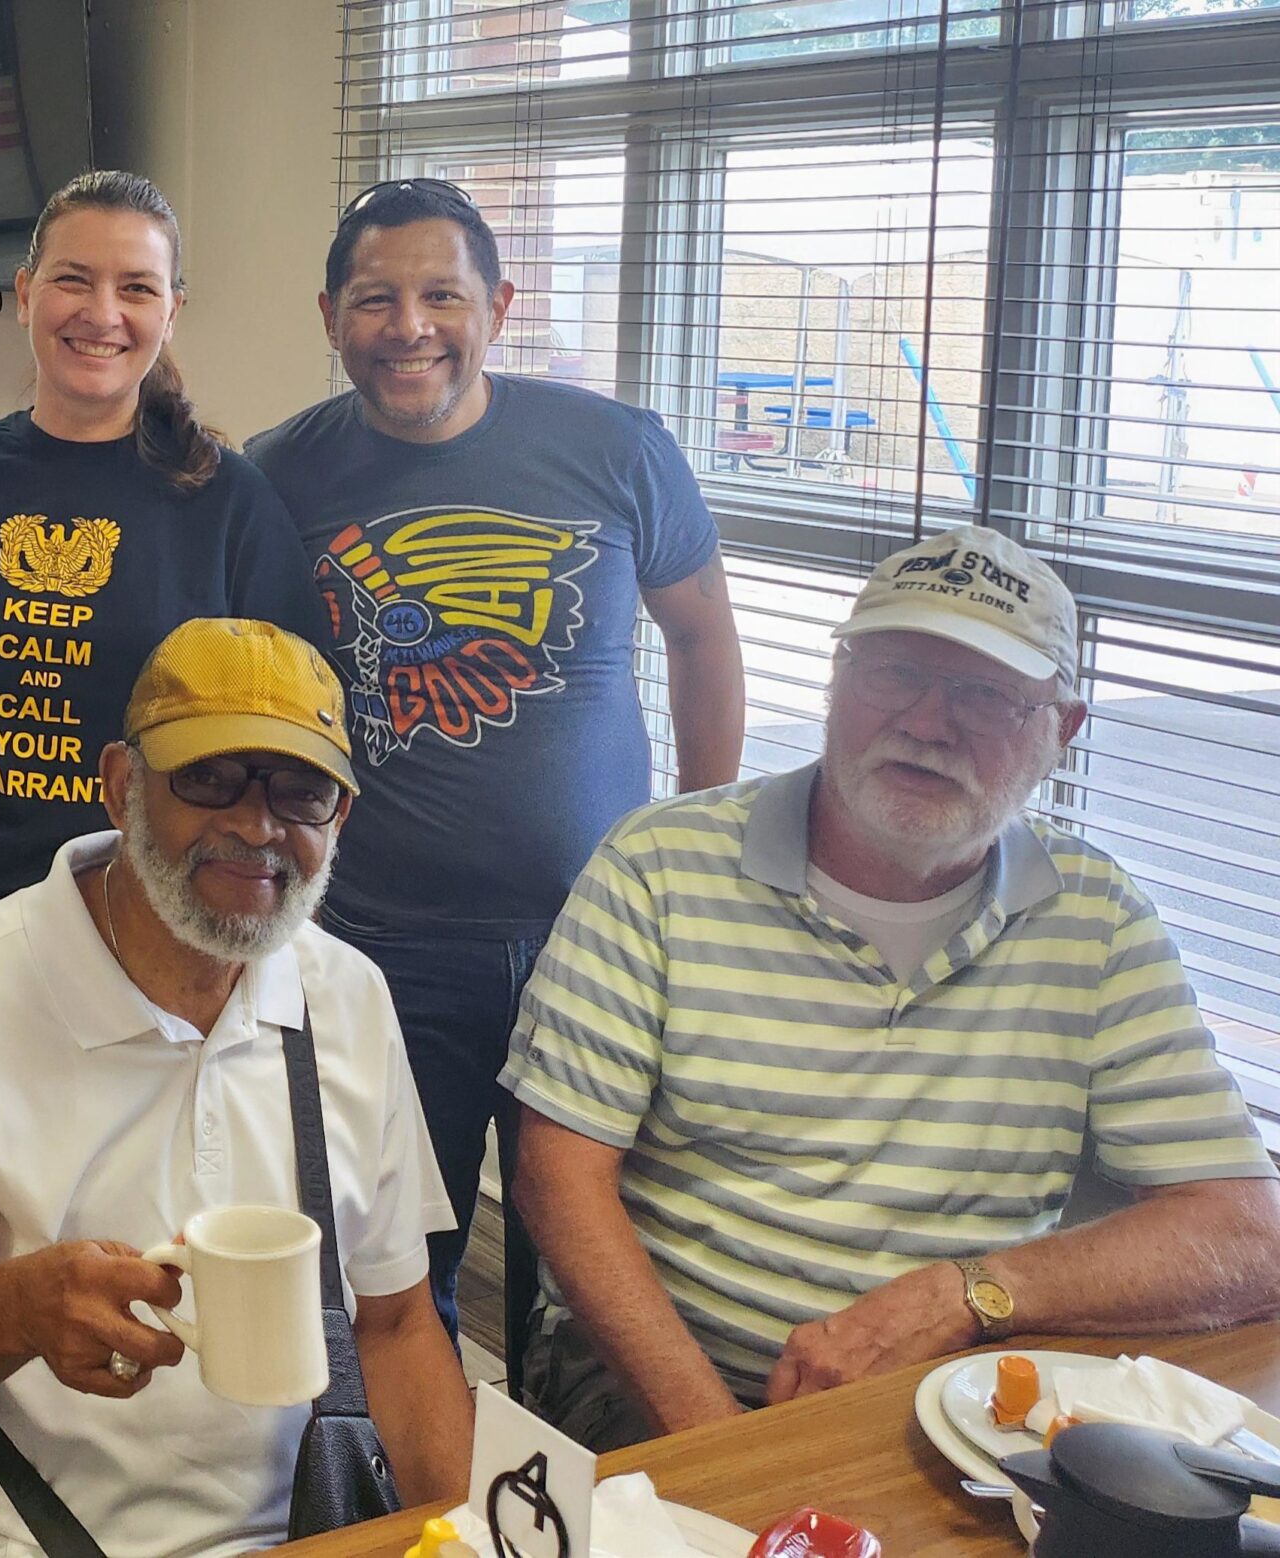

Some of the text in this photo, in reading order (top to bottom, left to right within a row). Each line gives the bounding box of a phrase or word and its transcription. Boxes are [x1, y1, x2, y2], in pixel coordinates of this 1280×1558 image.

[893, 549, 1030, 603] PENN STATE
[3, 597, 94, 628] KEEP
[892, 581, 1015, 614] NITTANY LIONS
[384, 611, 419, 634] 46
[383, 627, 482, 663] MILWAUKEE
[20, 670, 62, 688] AND
[387, 639, 537, 736] GOOD
